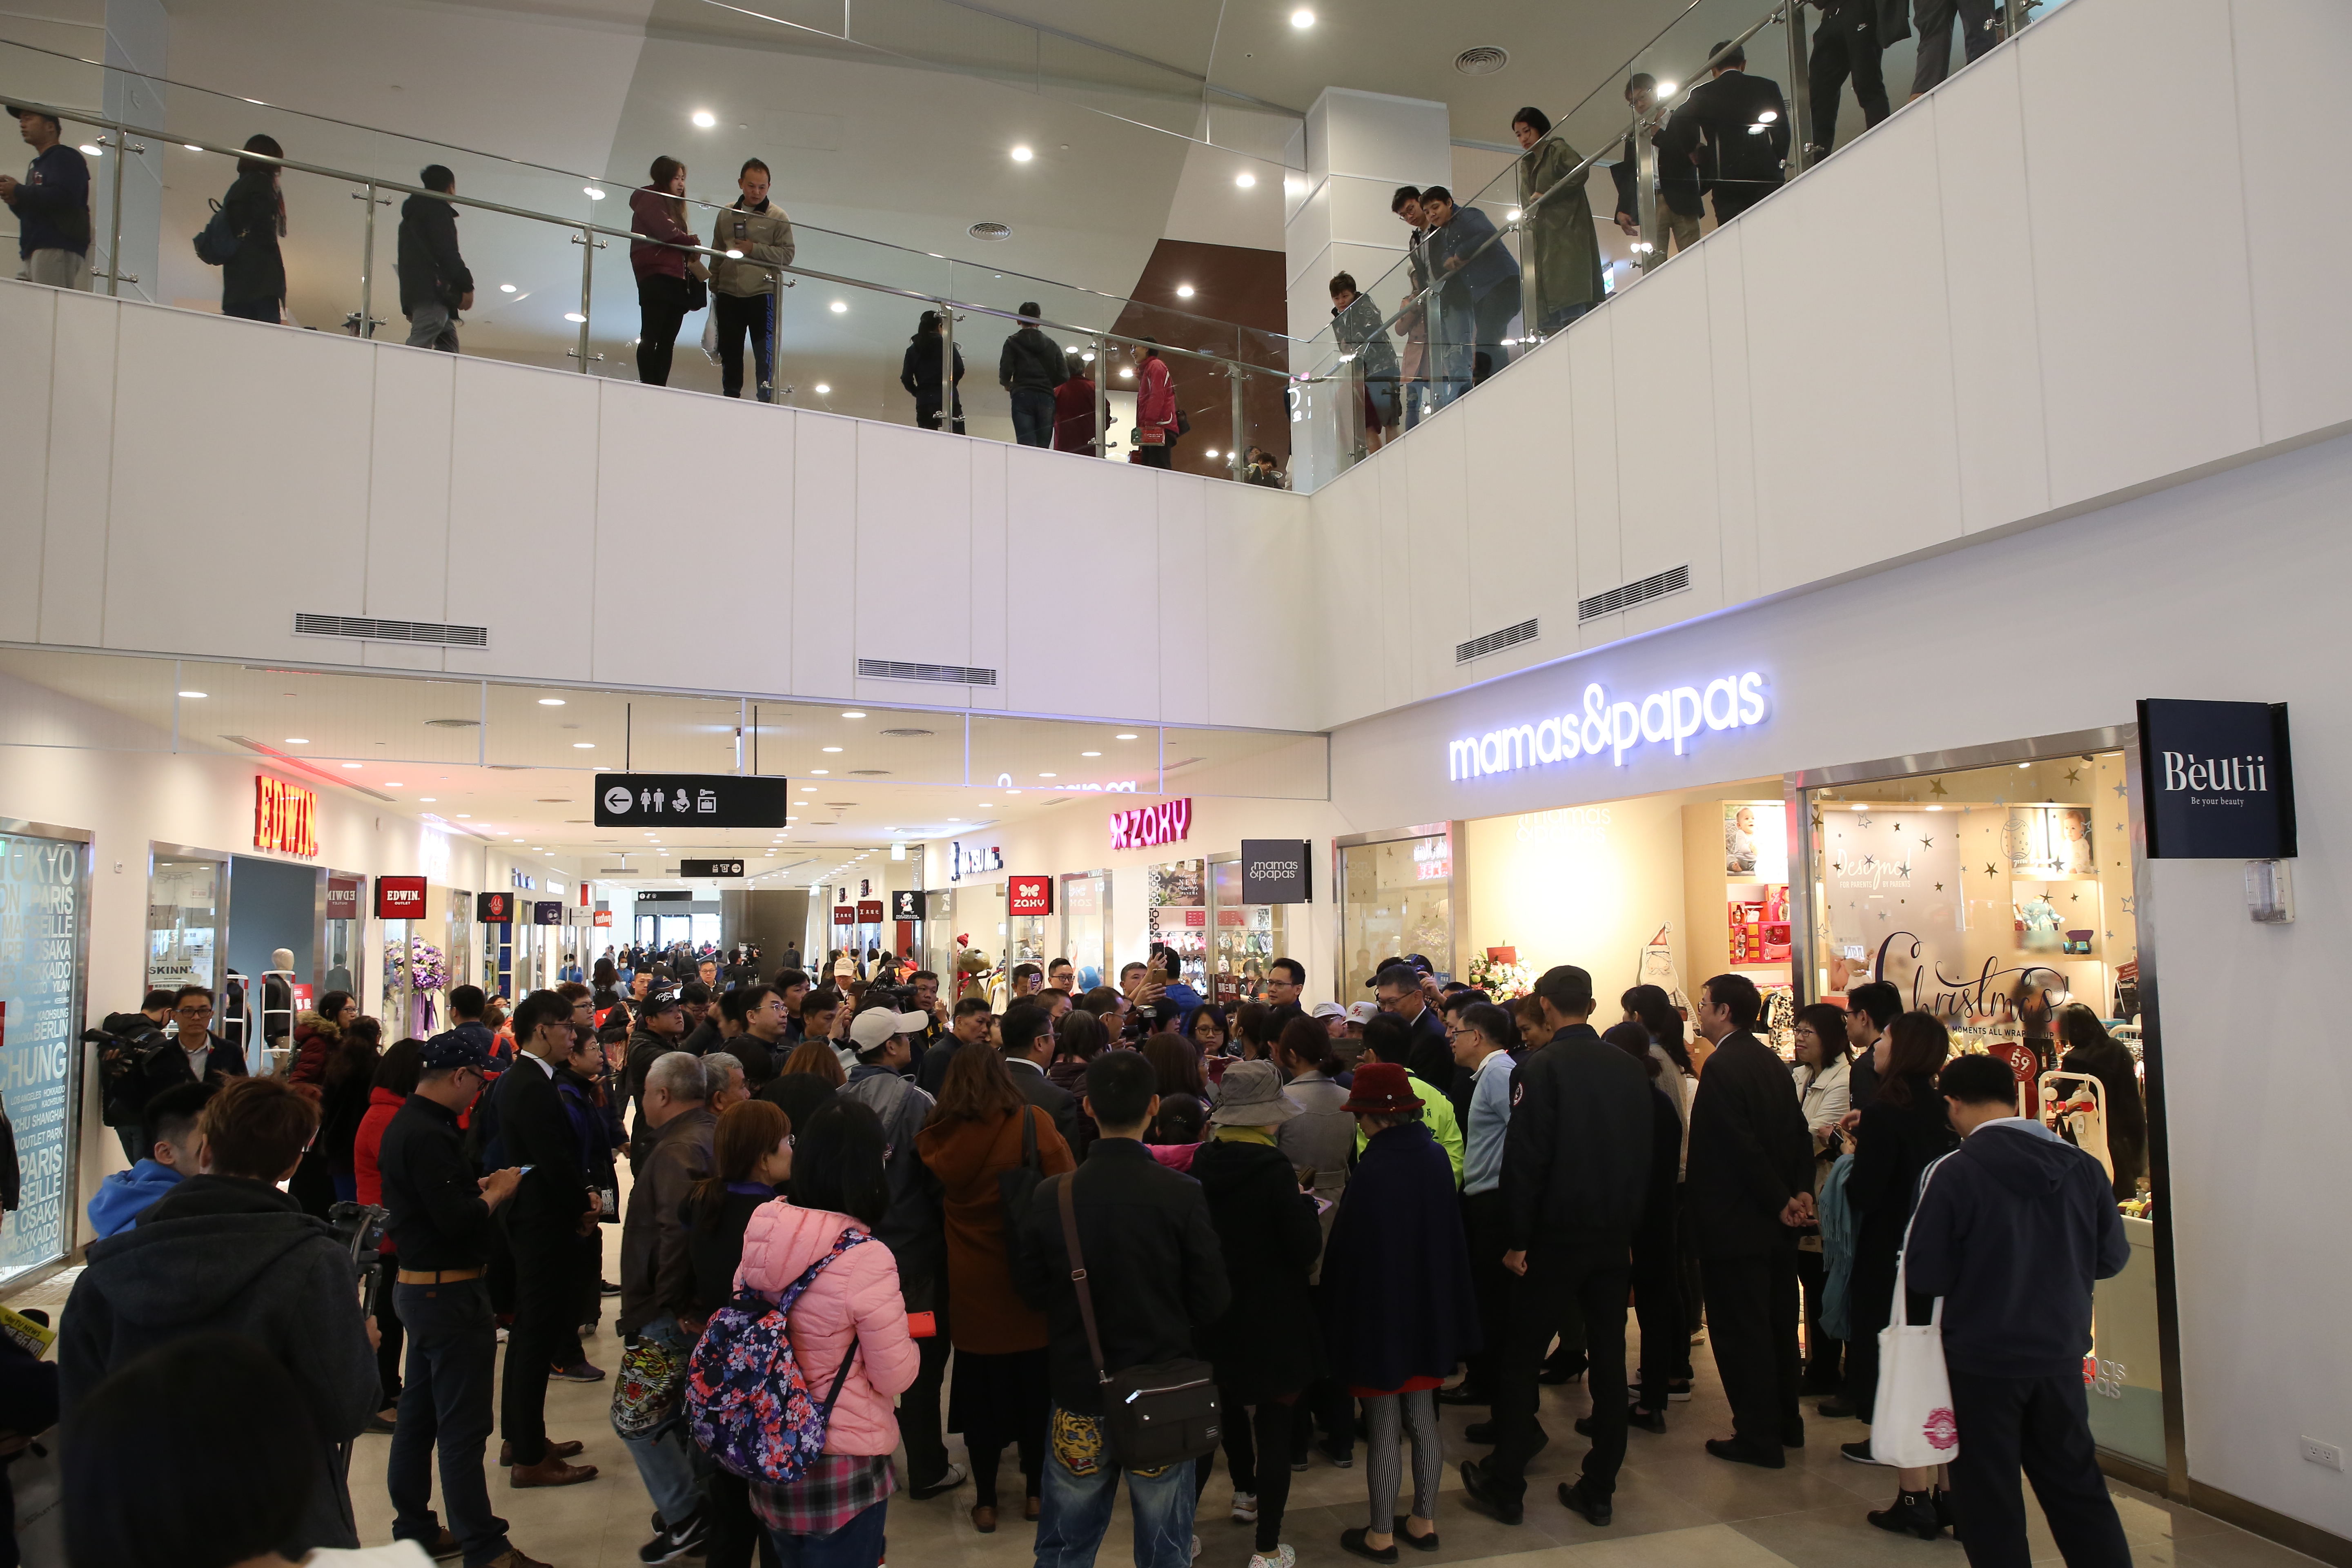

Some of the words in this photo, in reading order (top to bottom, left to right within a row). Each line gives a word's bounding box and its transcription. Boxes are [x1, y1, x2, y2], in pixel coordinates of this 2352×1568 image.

[1449, 672, 1771, 782] mamas&papas
[2162, 751, 2268, 791] Bèutii
[2202, 798, 2218, 807] your
[2221, 797, 2244, 807] beauty
[1129, 797, 1191, 848] zaxy
[1250, 866, 1295, 881] &papas
[1254, 861, 1298, 870] mamas
[1837, 847, 1911, 891] Designed
[30, 884, 74, 915] PARIS
[1013, 899, 1045, 907] zaxy
[2, 915, 73, 938] MARSEILLE
[33, 940, 71, 960] OSAKA
[148, 965, 197, 975] SKINNY
[1875, 931, 2067, 1023] Christmas
[53, 980, 70, 993] YILAN
[34, 1018, 68, 1041] BERLIN
[1952, 1025, 1987, 1035] MOMENTS
[11, 1095, 20, 1105] LOS
[21, 1091, 41, 1102] ANGELES
[44, 1085, 65, 1097] HOKKAIDO
[32, 1107, 65, 1128] SHANGHAI
[20, 1131, 46, 1150] OUTLET
[46, 1126, 64, 1142] PARK
[18, 1143, 62, 1184] PARIS
[21, 1200, 60, 1232] OSAKA
[40, 1238, 59, 1257] YILAN
[22, 1324, 42, 1337] NEWS
